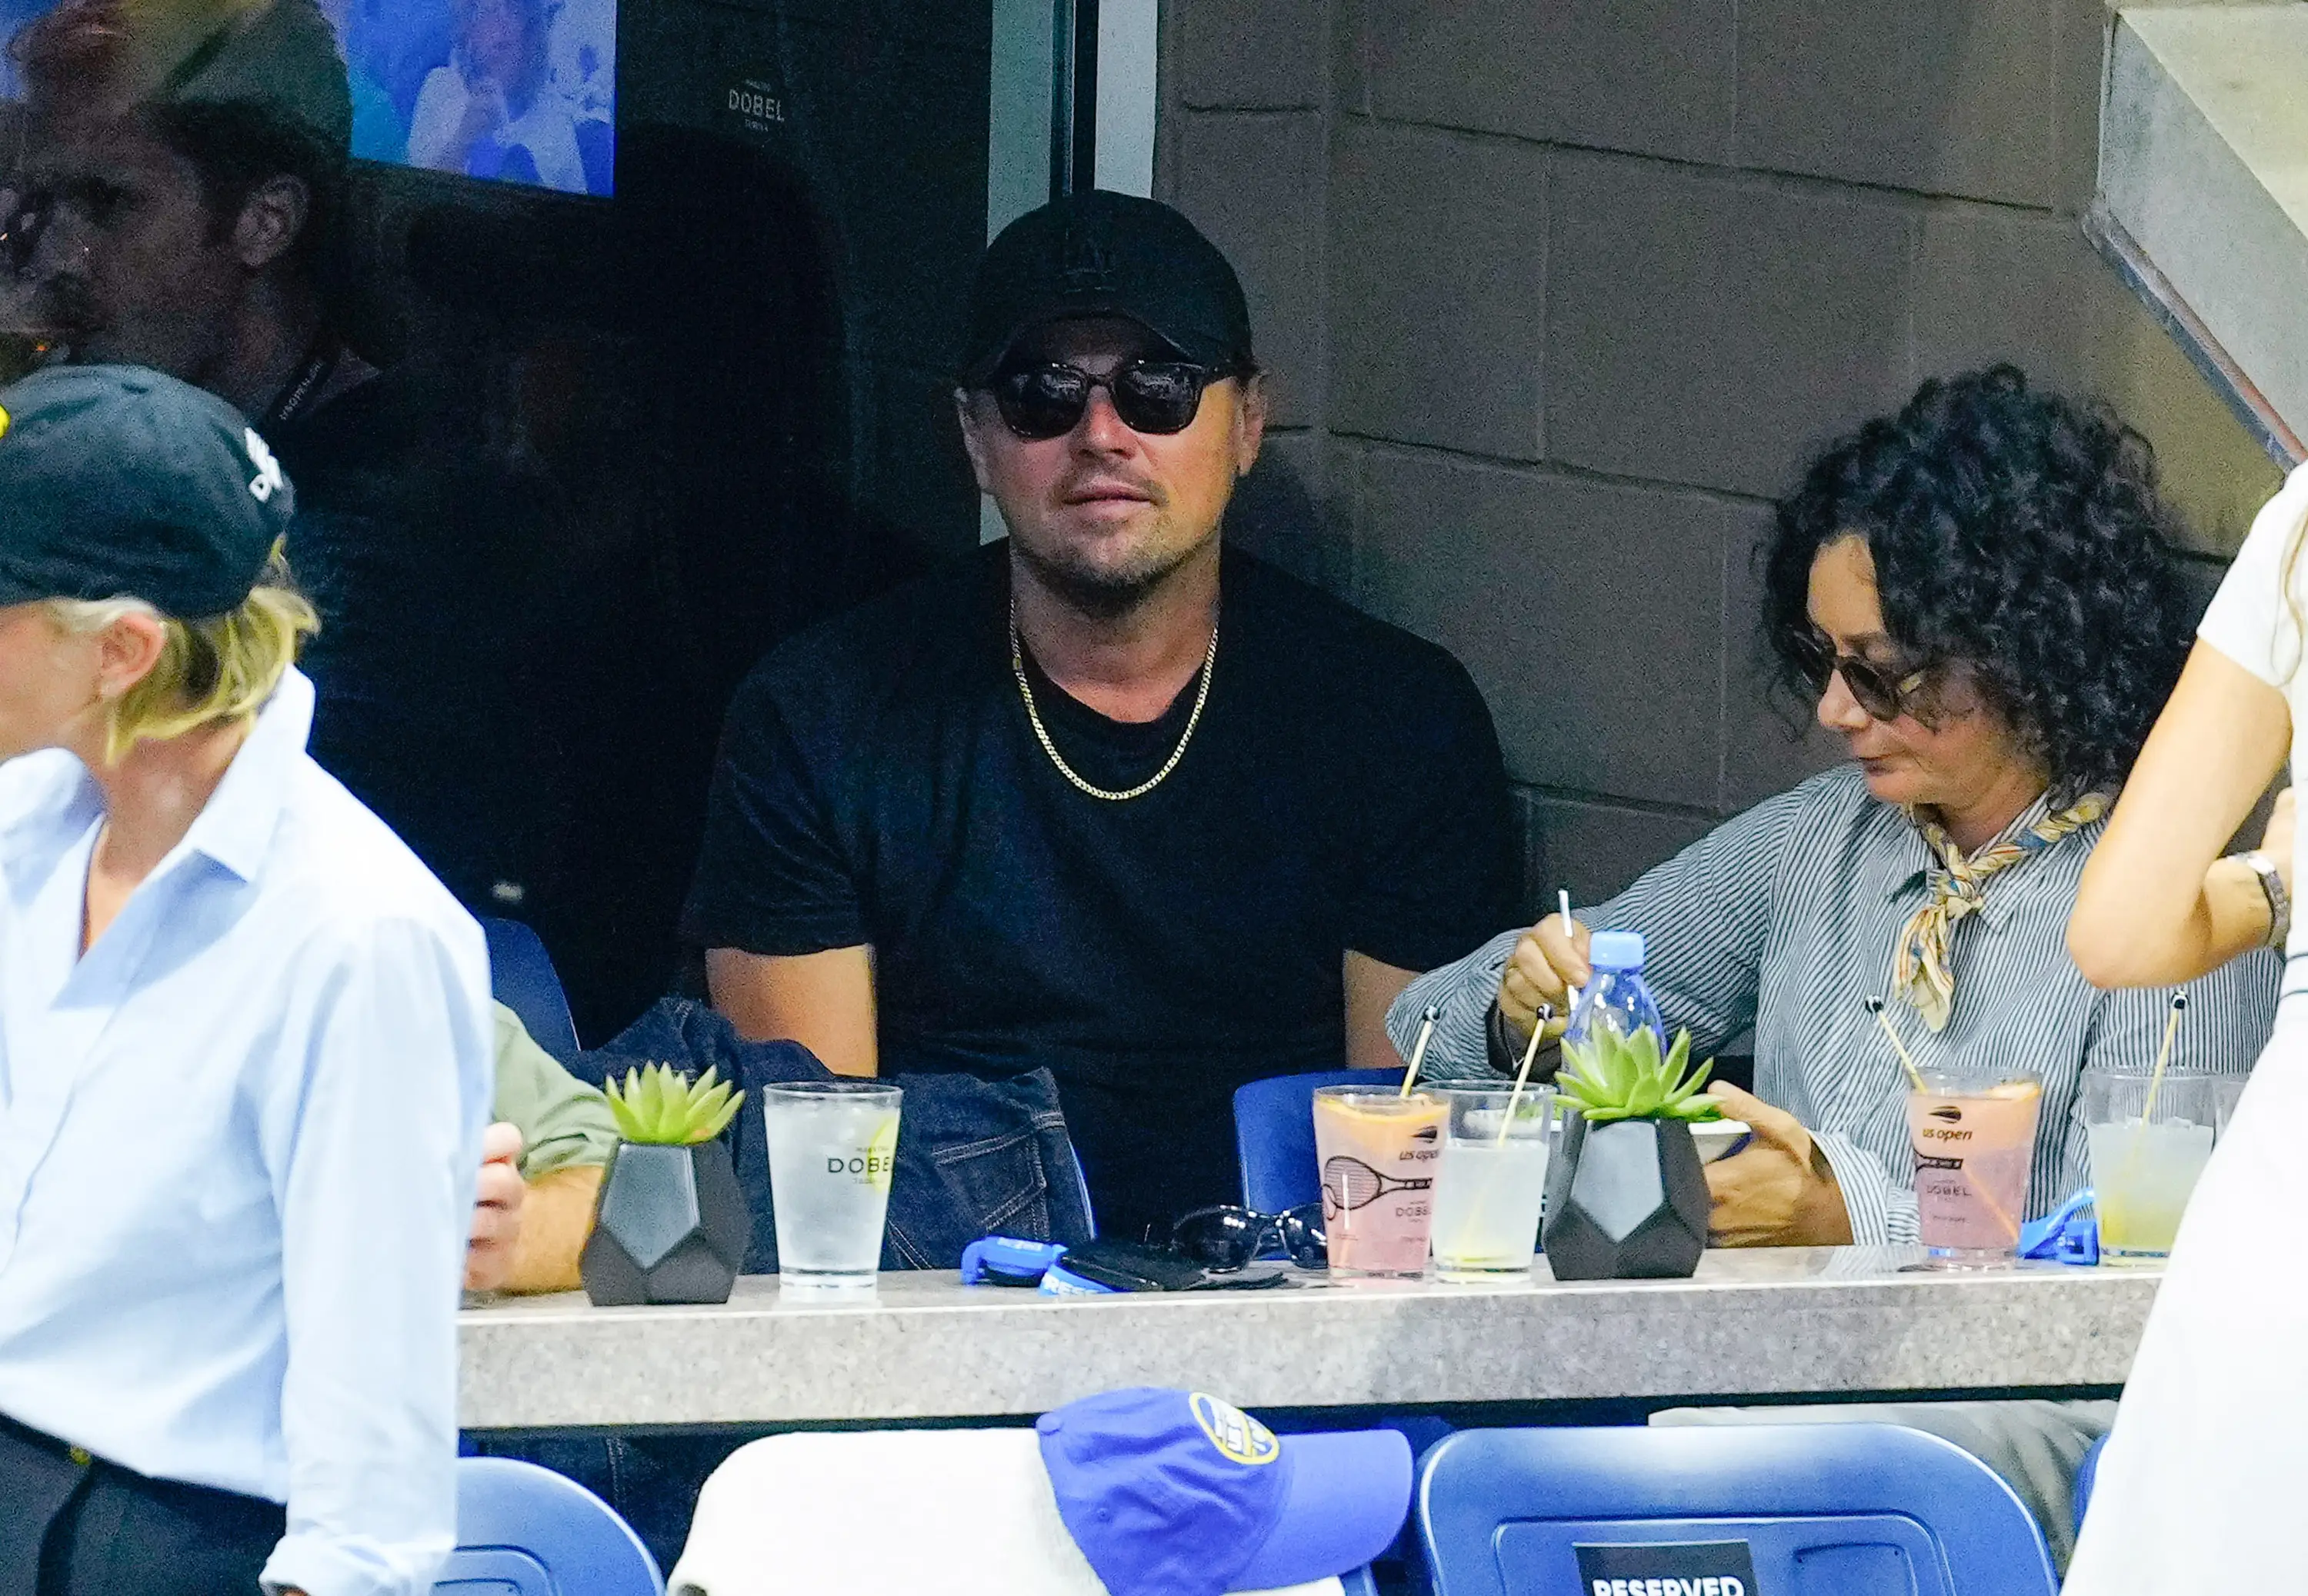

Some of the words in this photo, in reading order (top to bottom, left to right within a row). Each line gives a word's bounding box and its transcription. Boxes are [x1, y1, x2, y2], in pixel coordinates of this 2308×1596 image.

[729, 89, 785, 122] DOBEL
[1923, 1128, 1934, 1138] us
[1936, 1130, 1973, 1143] open
[1396, 1206, 1432, 1217] DOBE
[1592, 1576, 1746, 1596] RESERVED
